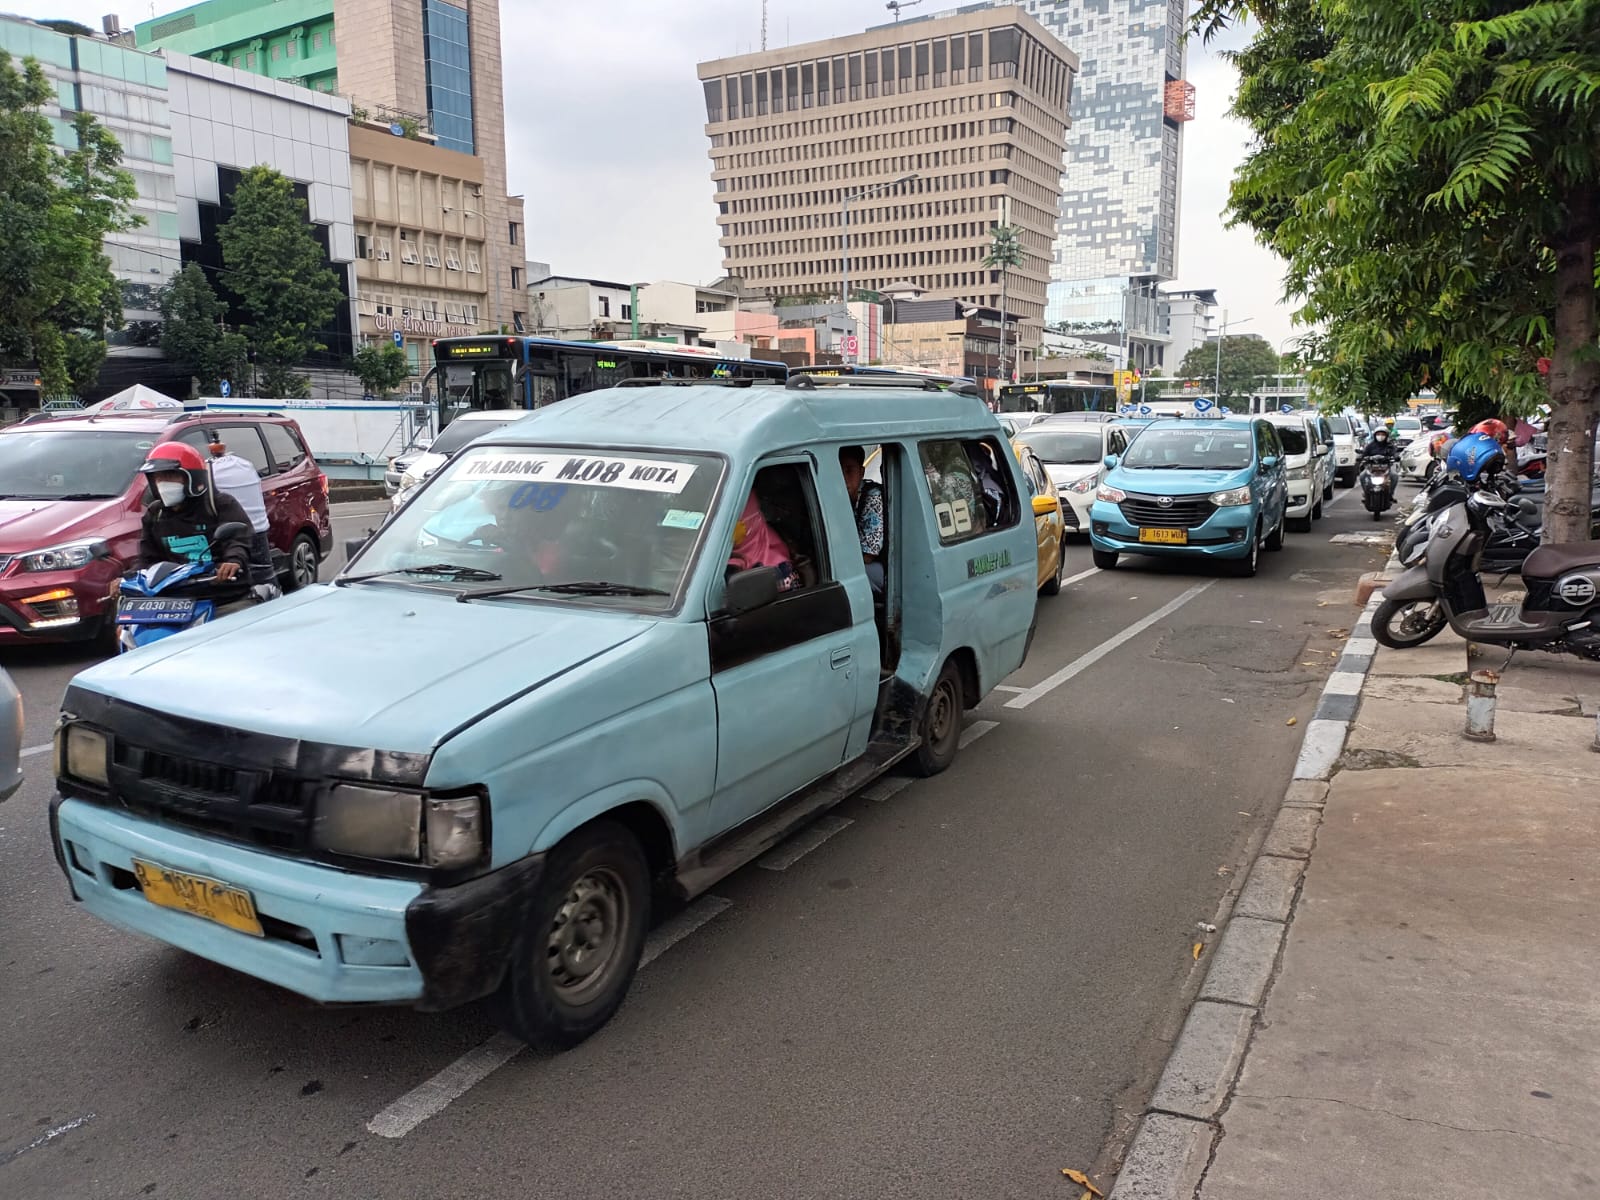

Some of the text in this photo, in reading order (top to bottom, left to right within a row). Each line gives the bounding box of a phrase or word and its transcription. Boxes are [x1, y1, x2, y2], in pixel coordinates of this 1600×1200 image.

[375, 313, 398, 331] The
[555, 458, 626, 483] M.08
[629, 465, 679, 485] KOTA
[507, 483, 568, 512] 08
[1562, 584, 1594, 597] 22
[126, 601, 134, 611] B
